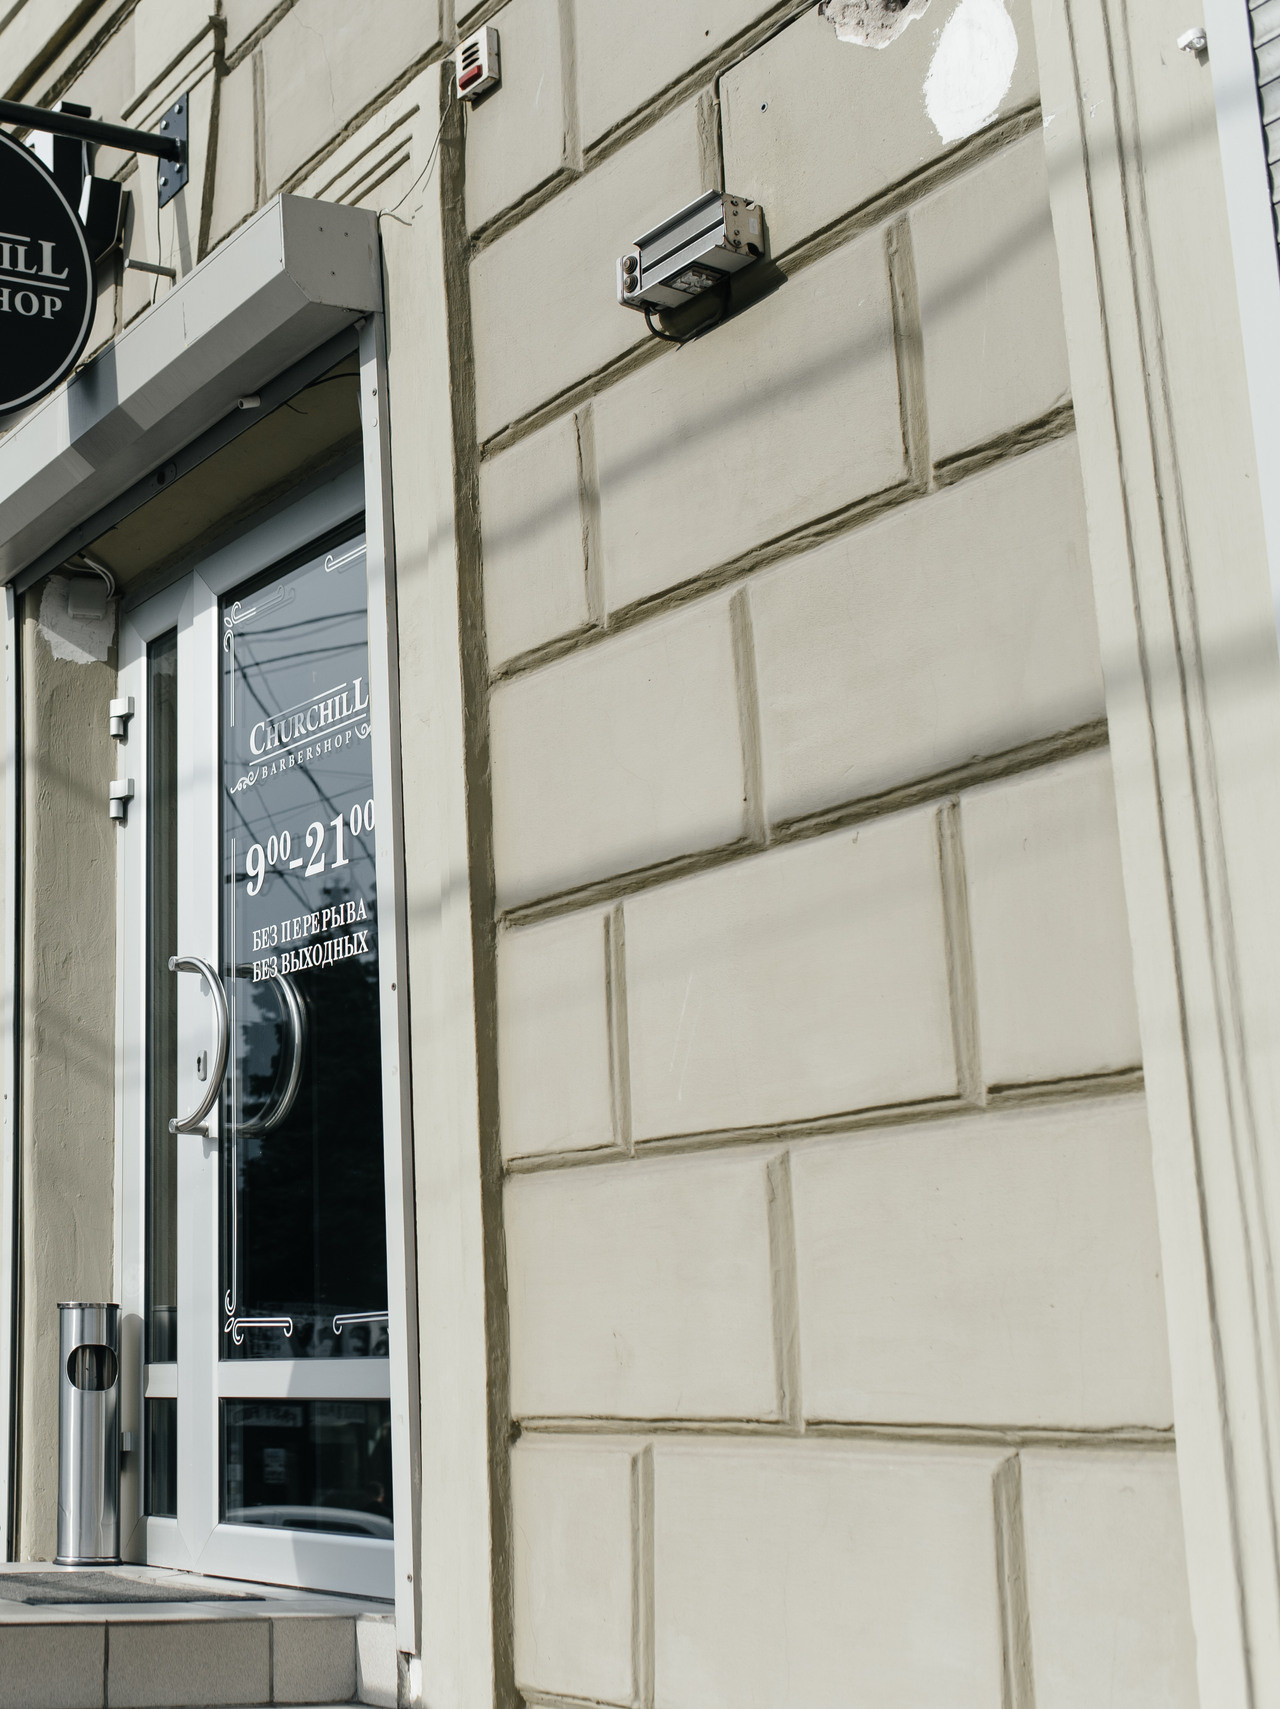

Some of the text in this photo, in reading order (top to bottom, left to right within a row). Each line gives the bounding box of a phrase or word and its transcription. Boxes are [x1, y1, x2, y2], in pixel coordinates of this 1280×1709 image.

[250, 677, 369, 755] CHURCHILL
[261, 730, 352, 779] BARBERSHOP
[253, 897, 368, 951] БЕЗ ПЕРЕРЫВА
[253, 930, 369, 983] БЕЗ ВЫХОДНЫХ
